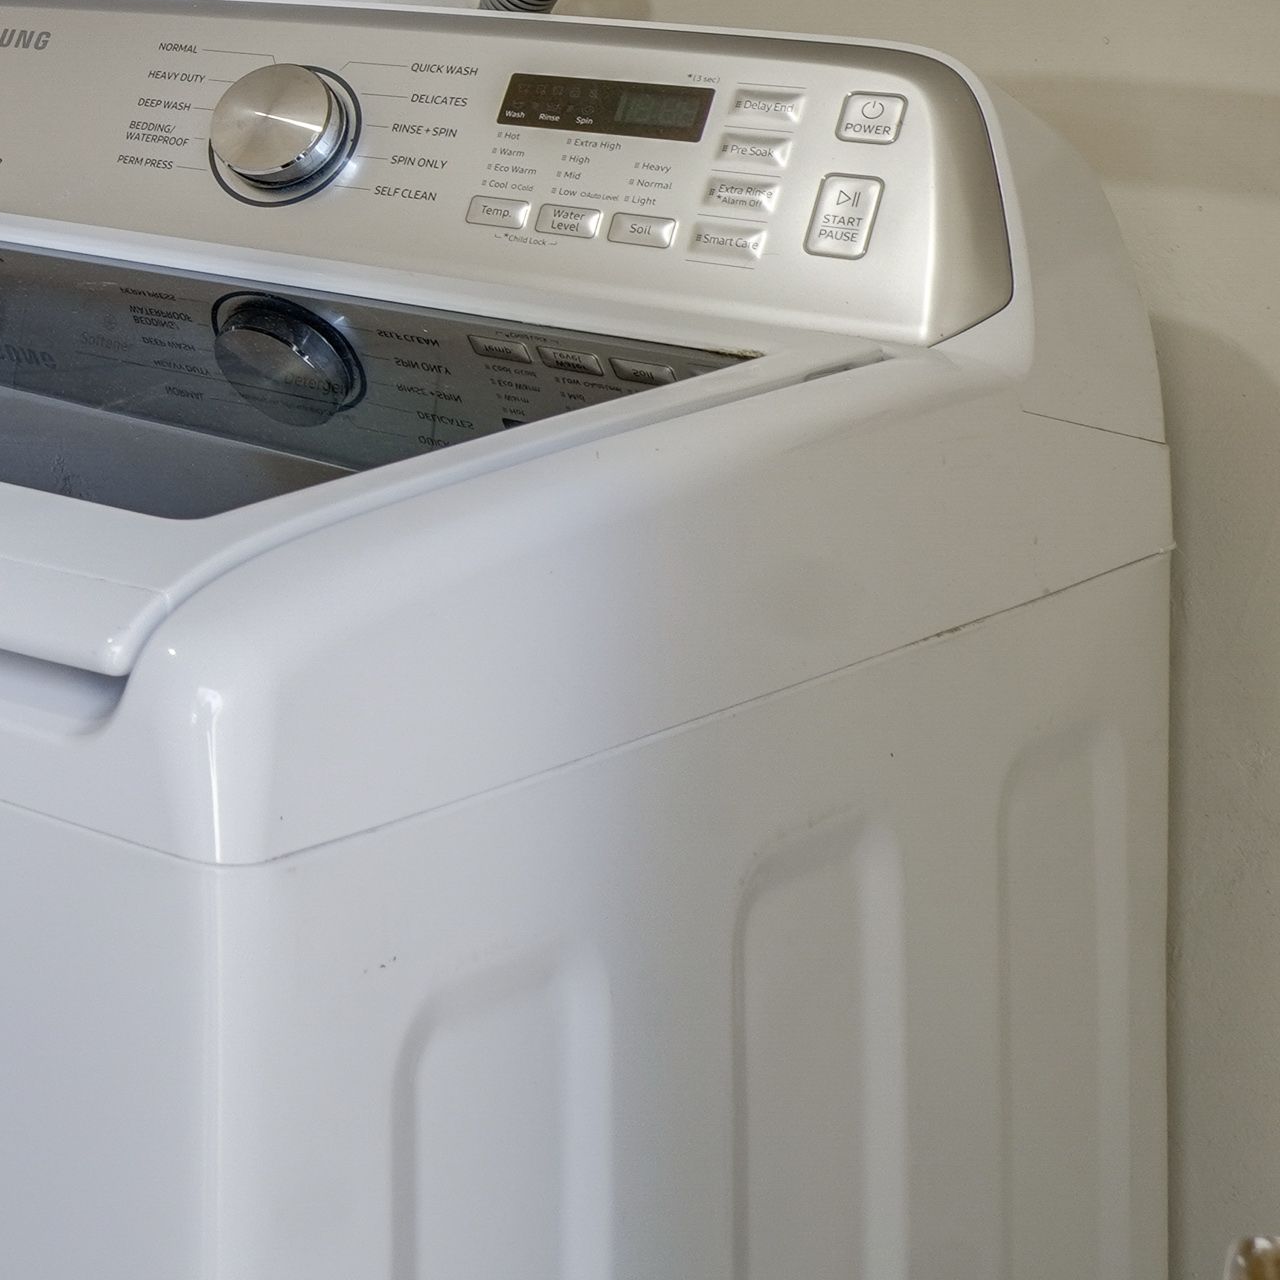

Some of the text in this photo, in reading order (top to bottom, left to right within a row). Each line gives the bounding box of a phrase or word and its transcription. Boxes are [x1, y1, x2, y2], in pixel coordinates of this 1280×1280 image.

[158, 43, 198, 53] NORMAL
[411, 62, 478, 76] QUICK WASH
[148, 70, 205, 83] HEAVY DUTY
[138, 98, 191, 111] DEEP WASH
[411, 94, 468, 107] DELICATES
[743, 100, 794, 112] Delay End
[505, 110, 594, 126] Wash Rinse Spin
[129, 121, 175, 133] BEDDING/
[392, 123, 422, 135] RINSE
[432, 127, 458, 138] SPIN
[844, 122, 891, 135] POWER
[126, 132, 189, 147] WATERPROOF
[504, 132, 520, 140] Hot
[574, 139, 622, 151] Extra High
[730, 145, 774, 157] Pre Soak
[499, 148, 525, 157] Warm
[117, 155, 173, 169] PERM PRESS
[391, 155, 448, 169] SPIN ONLY
[569, 155, 590, 164] High
[494, 164, 537, 175] Eco Warm
[642, 162, 672, 174] Heavy
[564, 171, 581, 180] Mid
[489, 180, 508, 190] Cool
[637, 179, 672, 190] Normal
[718, 184, 743, 195] Extra
[374, 186, 437, 201] SELF CLEAN
[559, 188, 577, 197] Low
[631, 196, 656, 206] Light
[481, 205, 512, 218] Temp.
[553, 209, 586, 221] Water
[551, 221, 579, 232] Level
[822, 214, 864, 228] START
[629, 224, 651, 235] Soil
[529, 237, 547, 246] Lock
[703, 234, 759, 250] Smart Care
[818, 229, 859, 243] PAUSE
